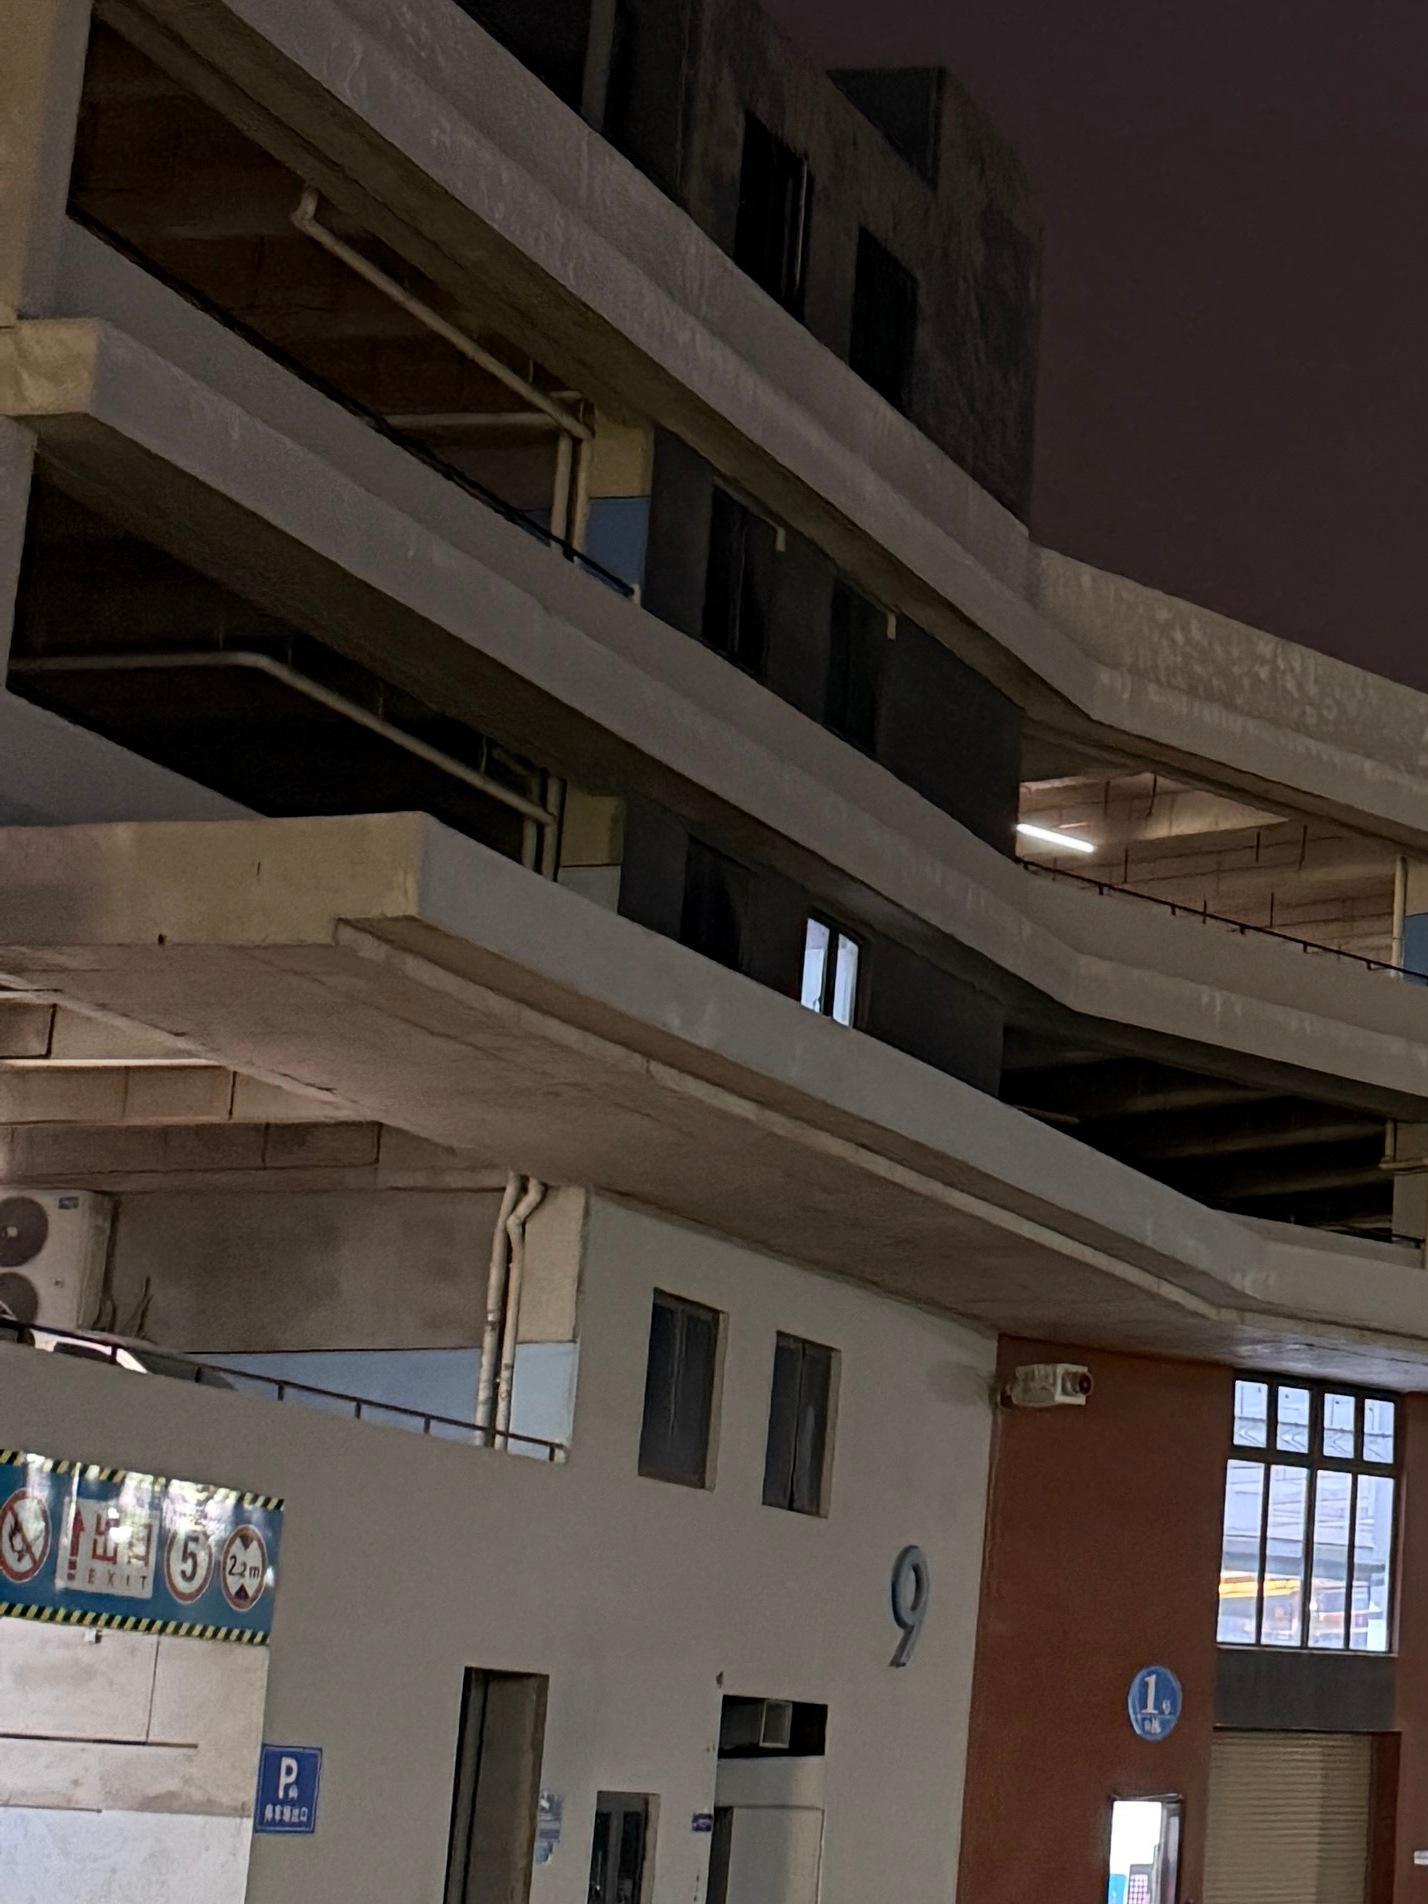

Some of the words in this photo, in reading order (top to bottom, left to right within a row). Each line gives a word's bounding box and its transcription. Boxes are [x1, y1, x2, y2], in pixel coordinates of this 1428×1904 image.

[88, 1568, 148, 1591] EXIT
[181, 1534, 200, 1582] 5
[889, 1544, 930, 1667] 9
[278, 1756, 298, 1800] P
